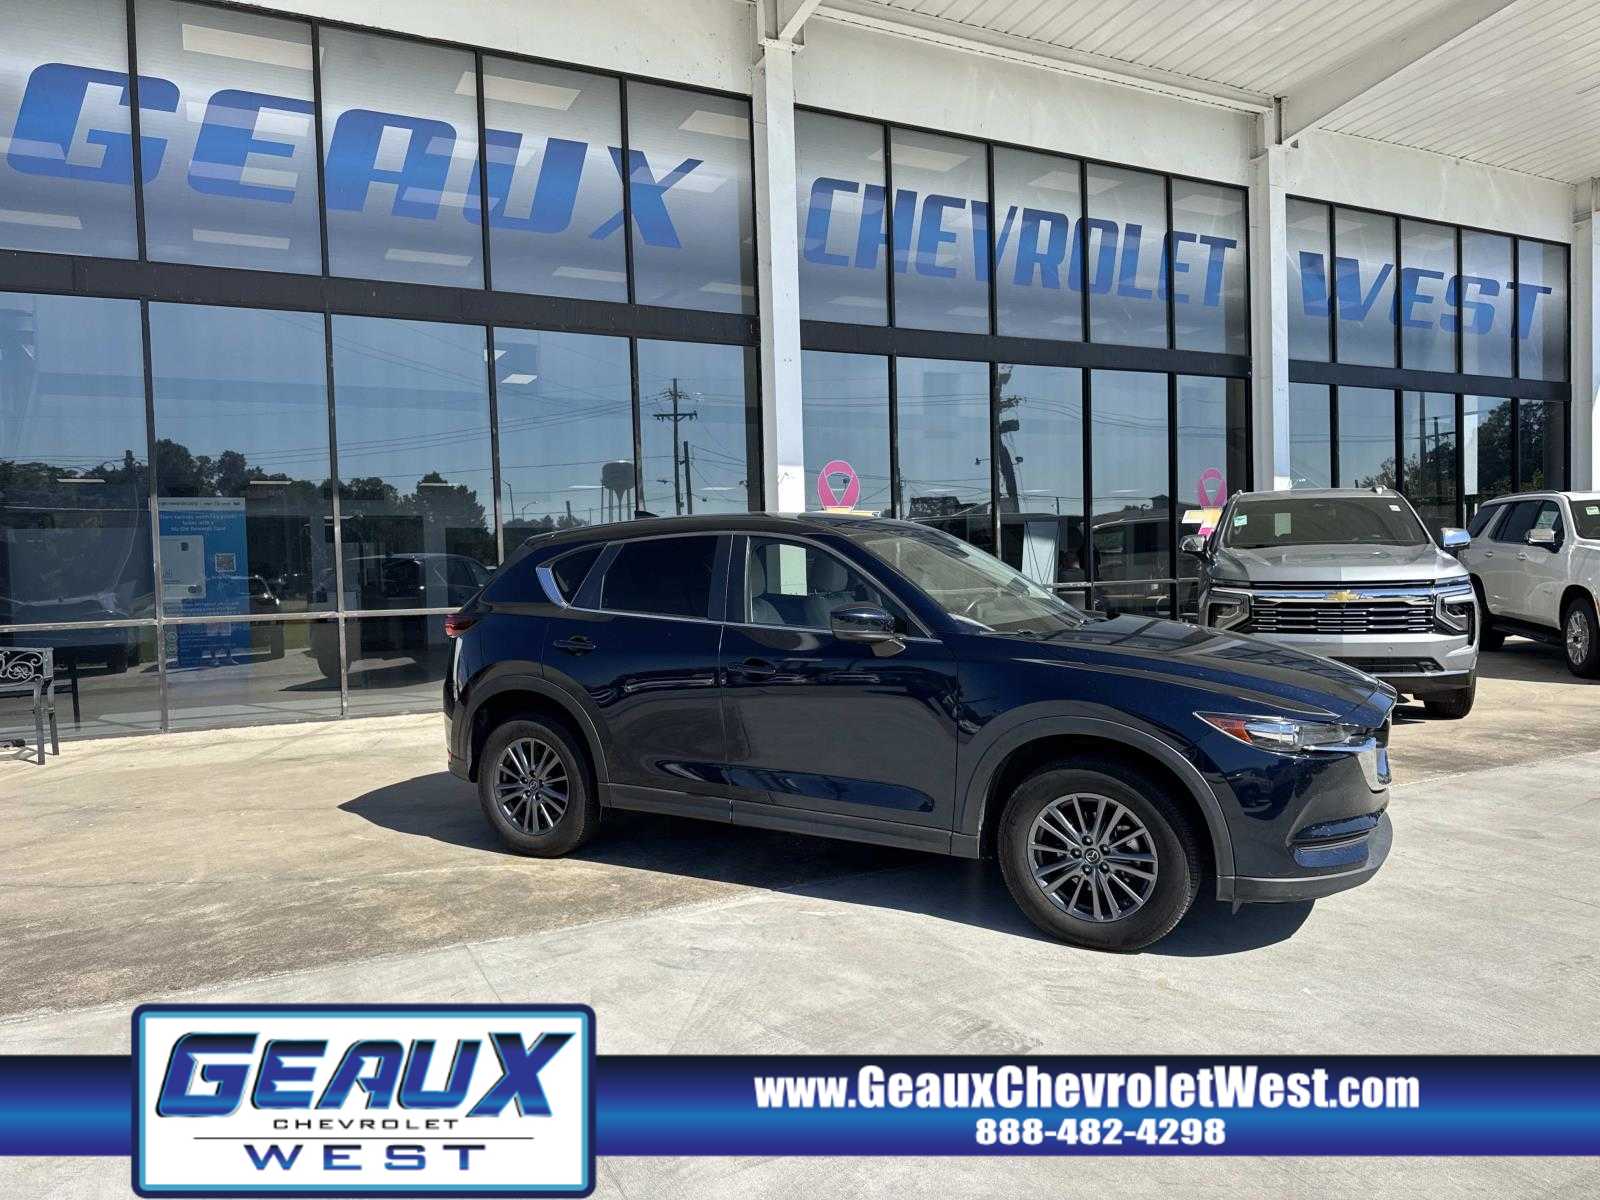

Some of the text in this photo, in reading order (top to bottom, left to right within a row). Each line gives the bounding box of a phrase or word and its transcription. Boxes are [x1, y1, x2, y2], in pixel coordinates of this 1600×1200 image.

[7, 62, 1552, 339] GEAUX CHEVROLET WEST
